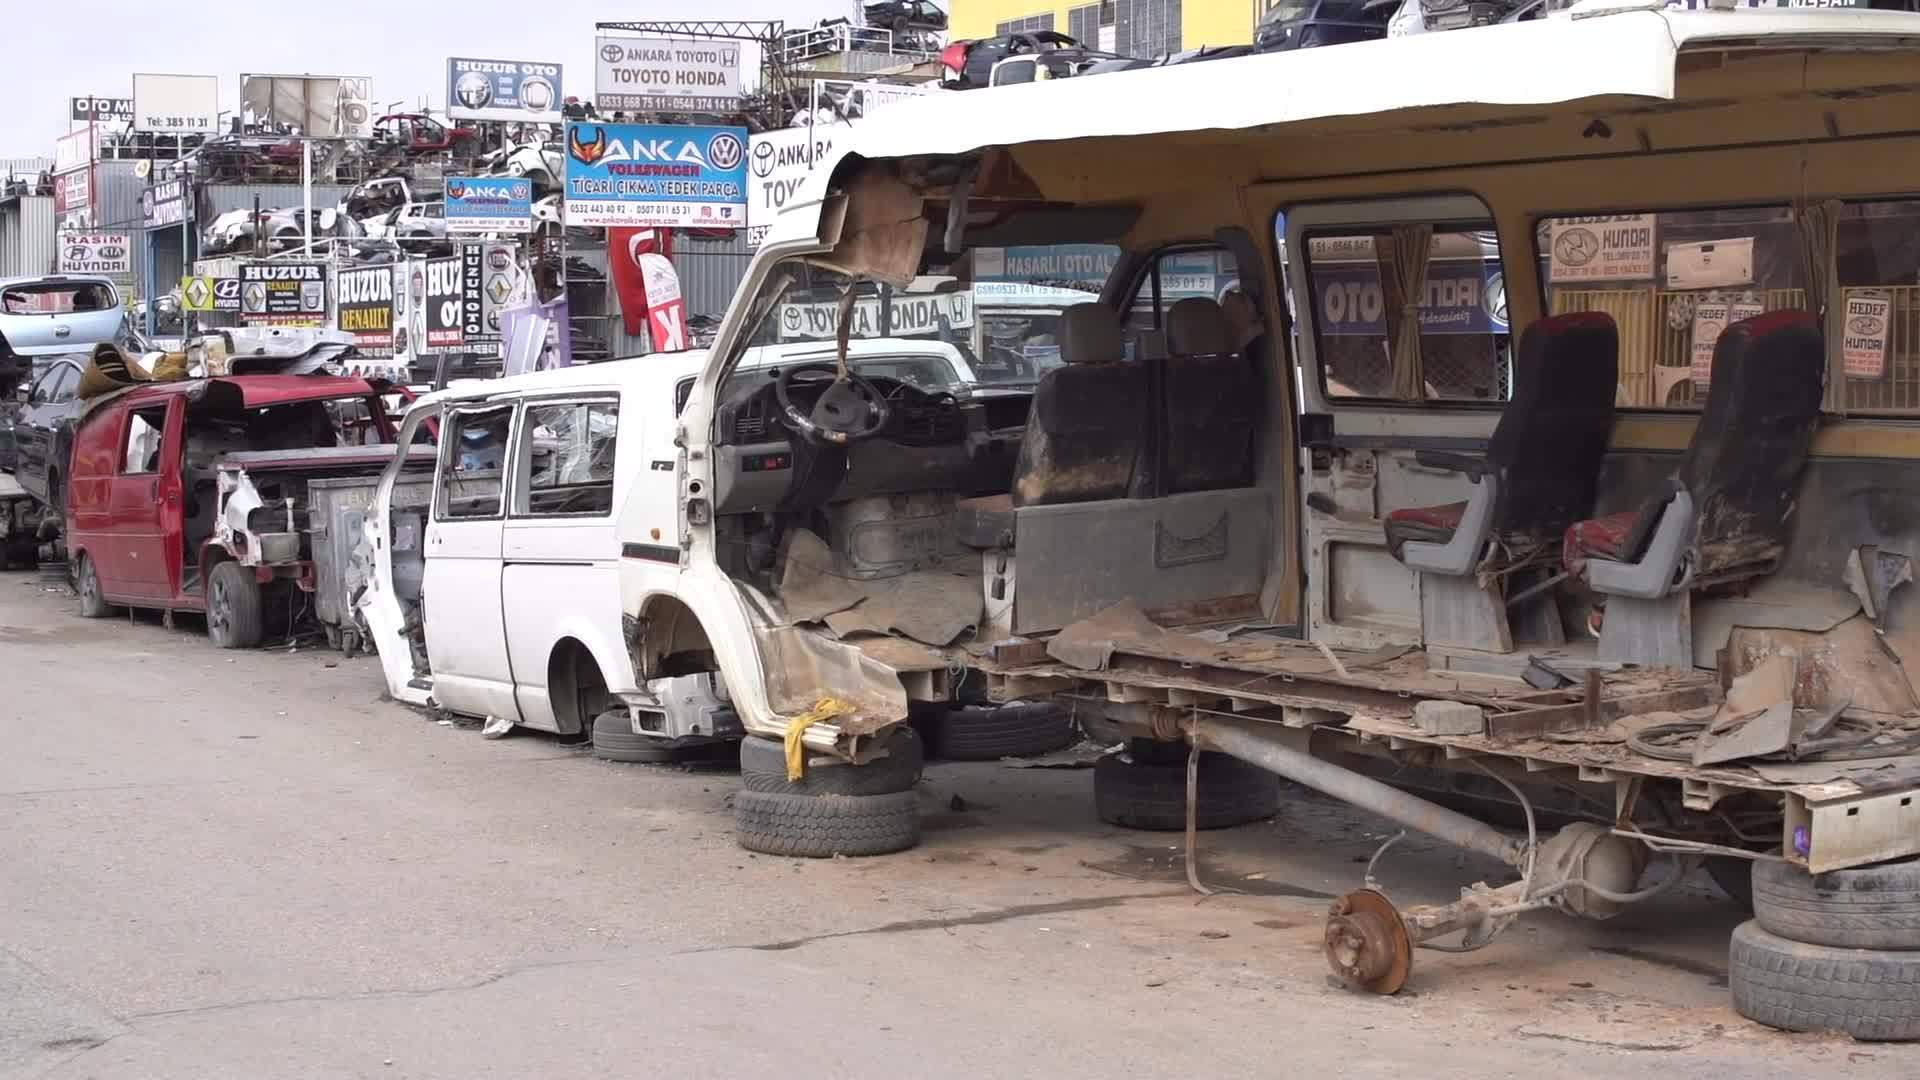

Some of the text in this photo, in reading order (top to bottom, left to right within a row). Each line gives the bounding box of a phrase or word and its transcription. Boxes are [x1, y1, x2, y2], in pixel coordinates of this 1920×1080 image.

[627, 48, 717, 63] ANKARA TOYOTO
[456, 61, 558, 76] HUZUR OTO
[612, 68, 726, 86] TOYOTO HONDA
[76, 99, 110, 112] OTO
[601, 96, 621, 108] 0533
[656, 98, 665, 109] 11
[166, 118, 184, 127] 385
[187, 118, 195, 127] 11
[198, 119, 208, 127] 31
[593, 138, 712, 172] ANKA
[608, 163, 700, 177] VOLKSWAGEN
[461, 186, 513, 201] ANKA
[615, 179, 656, 199] ÇIKMA
[659, 180, 698, 196] YEDEK
[699, 183, 740, 201] PARÇA
[570, 205, 588, 214] 0532
[1006, 255, 1060, 276] HASARLI
[1063, 254, 1093, 273] OTO
[245, 266, 321, 280] HUZUR
[338, 268, 393, 304] HUZUR
[1325, 281, 1384, 324] OTO
[1848, 302, 1887, 316] HEDEF
[341, 307, 390, 331] RENAULT
[466, 302, 481, 334] OTO
